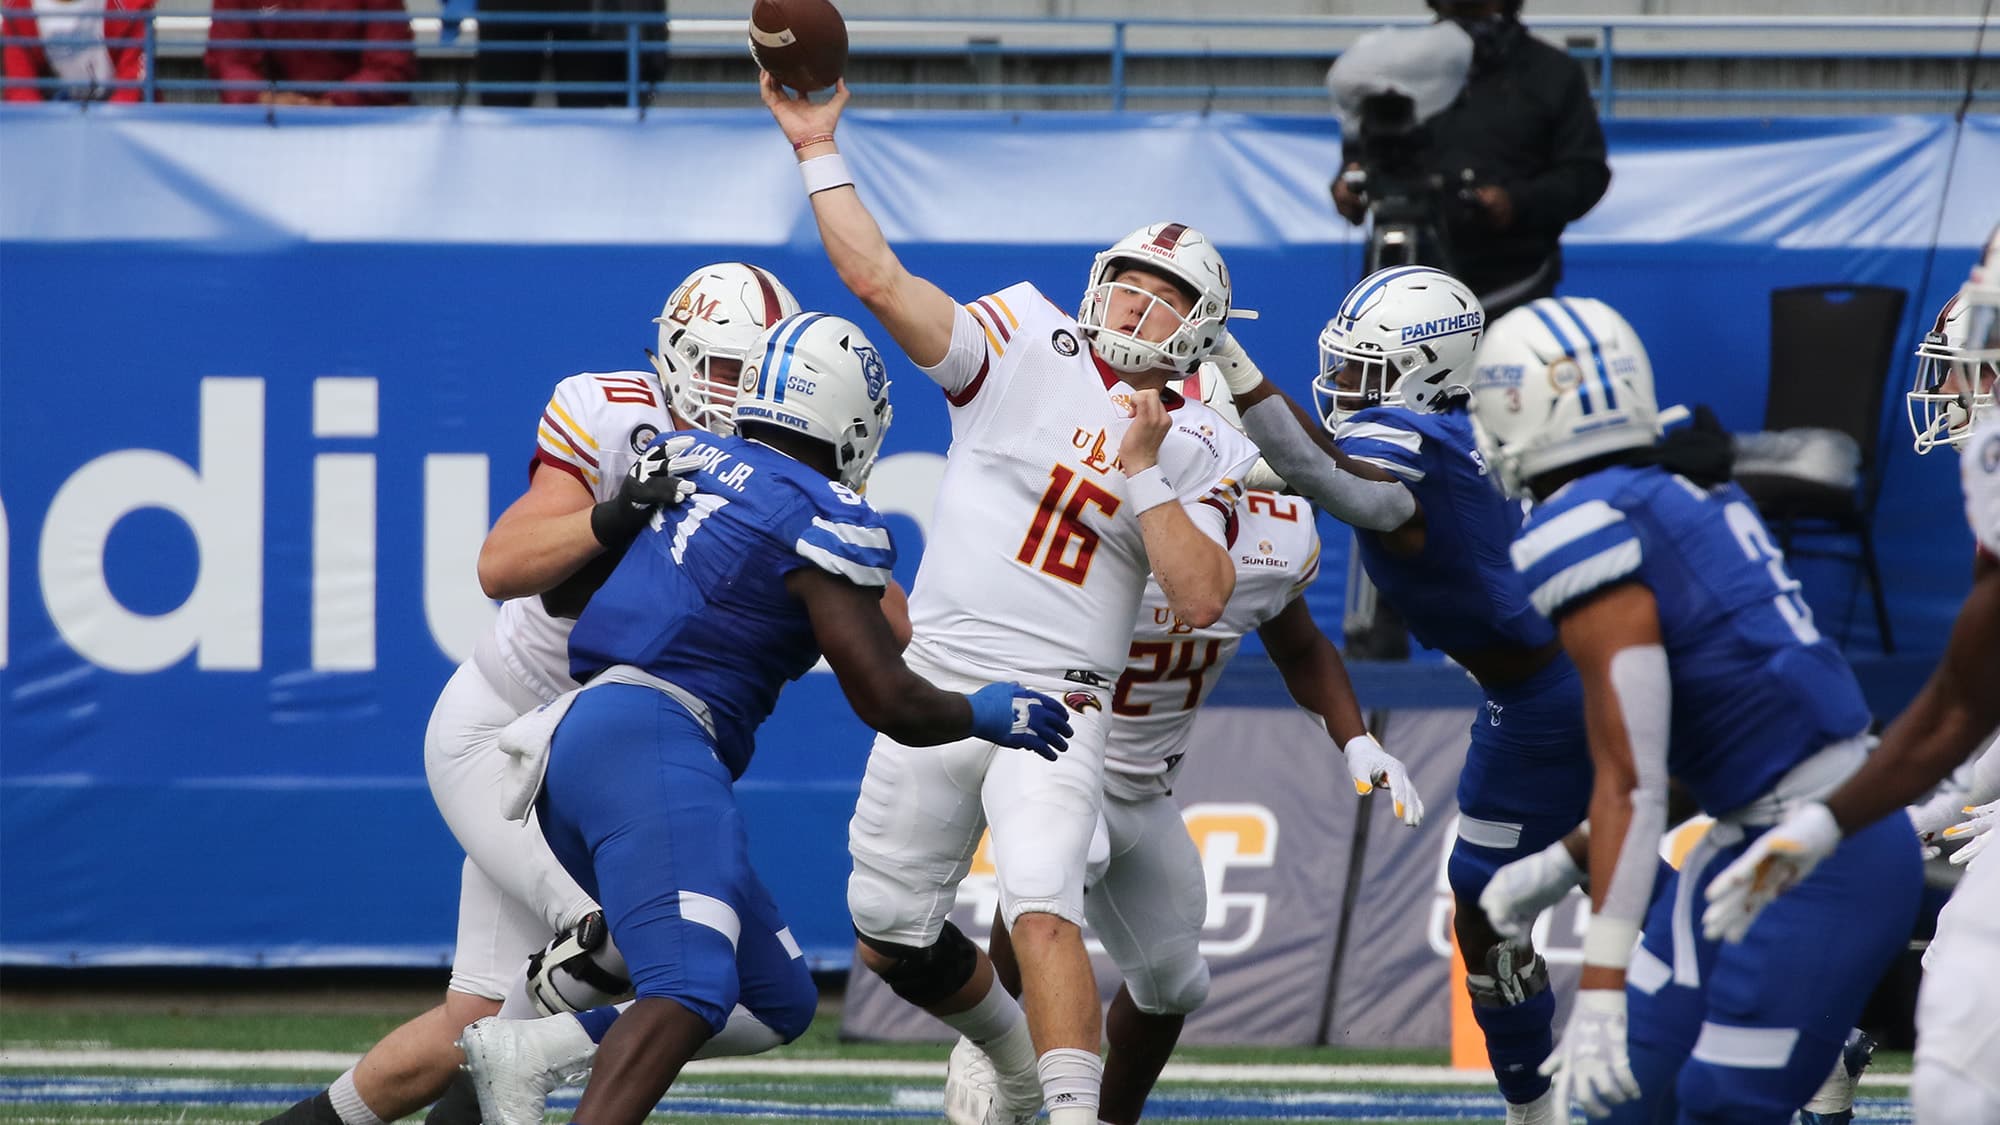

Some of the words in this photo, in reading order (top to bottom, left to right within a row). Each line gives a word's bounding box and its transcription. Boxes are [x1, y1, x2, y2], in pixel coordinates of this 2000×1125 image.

[1401, 311, 1480, 341] PANTHERS
[593, 376, 658, 408] 70
[787, 375, 816, 396] SBC
[737, 406, 773, 419] GEORGIA
[775, 412, 809, 431] STATE
[717, 462, 755, 493] JR.
[1014, 462, 1123, 588] 16
[1241, 555, 1264, 565] SUN
[1265, 557, 1289, 568] BELT
[1112, 639, 1222, 717] 24
